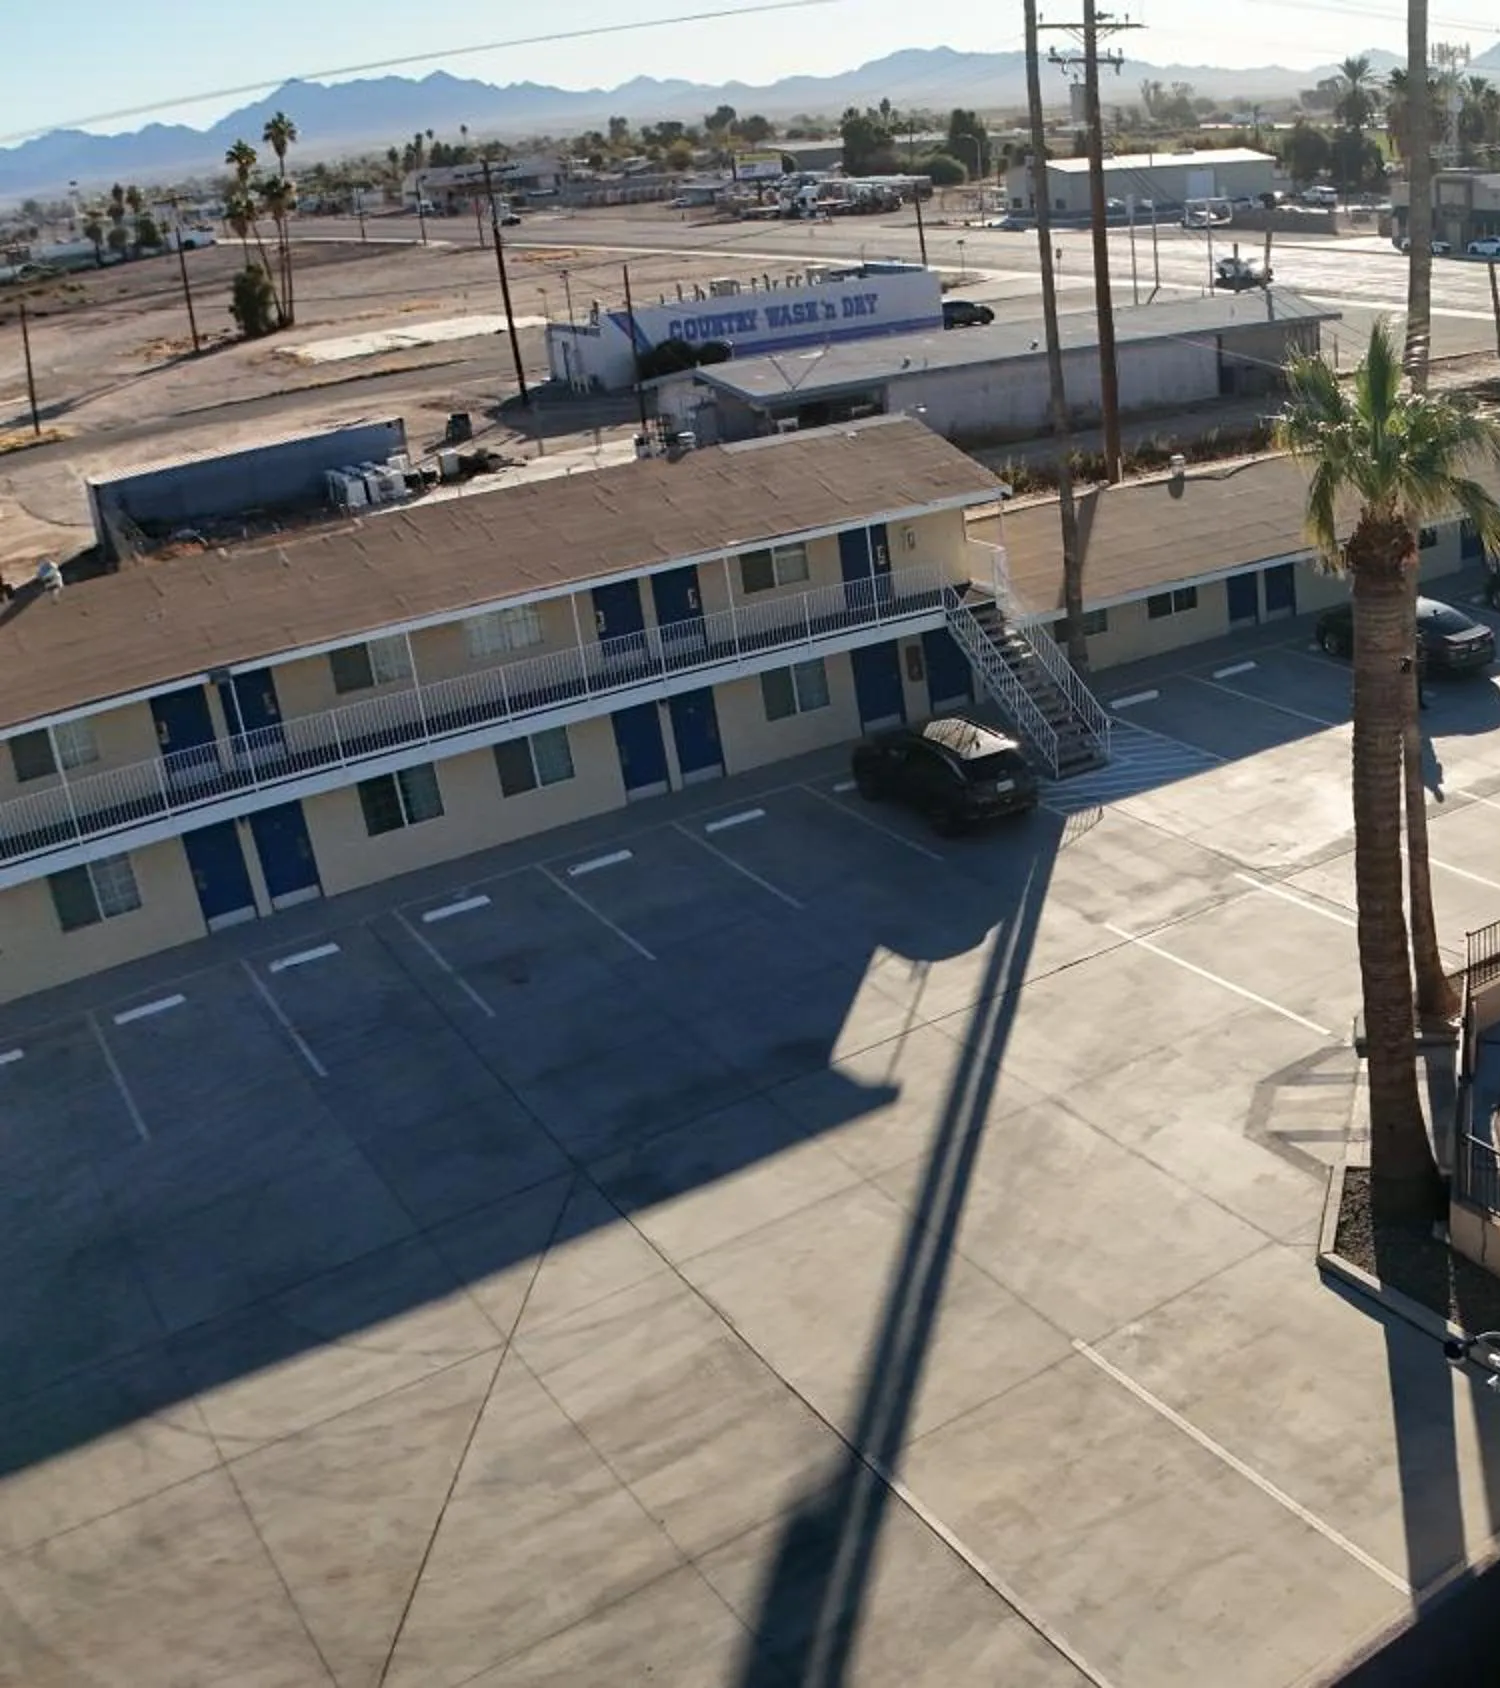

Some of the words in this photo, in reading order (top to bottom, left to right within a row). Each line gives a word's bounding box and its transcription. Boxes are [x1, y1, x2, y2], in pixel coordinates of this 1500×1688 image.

[669, 308, 759, 341] COUNTRY
[764, 301, 818, 329] WASH
[841, 293, 879, 318] DRY
